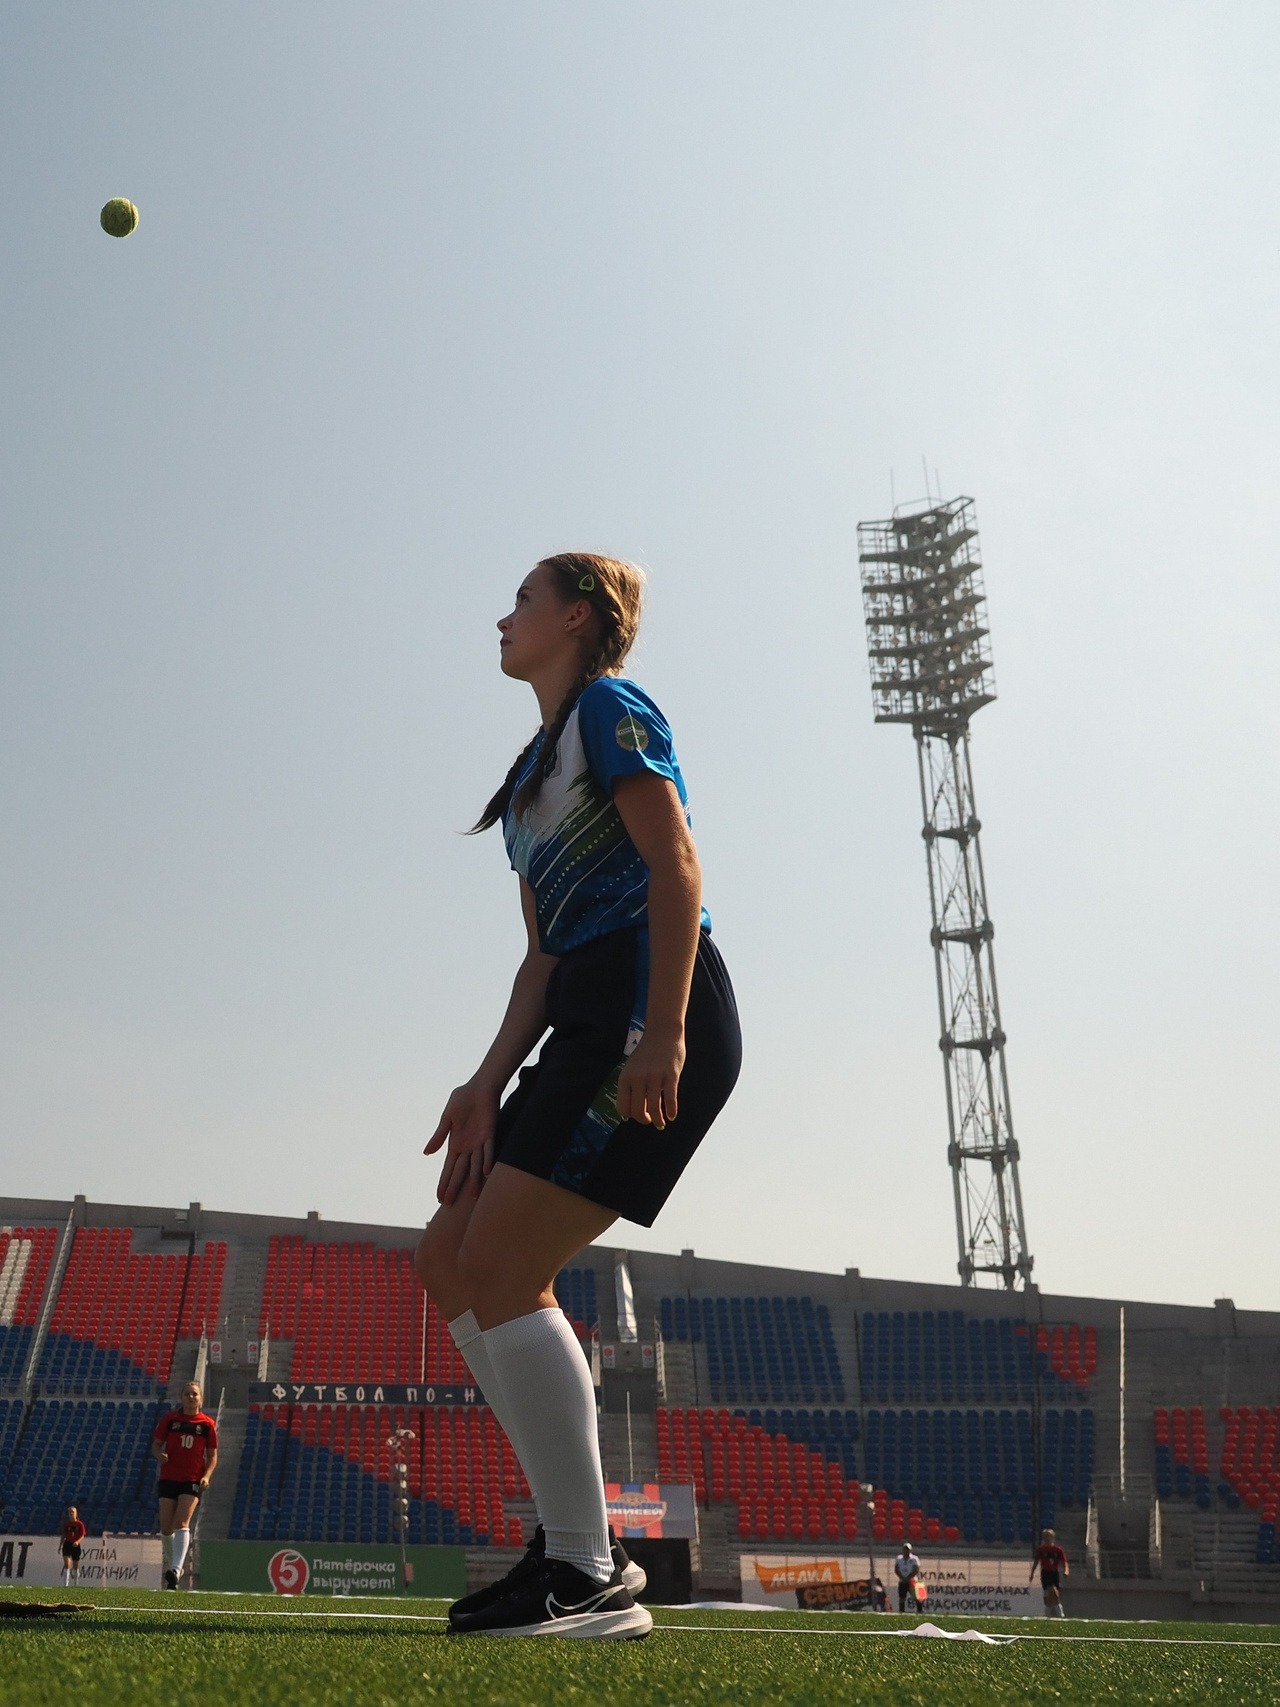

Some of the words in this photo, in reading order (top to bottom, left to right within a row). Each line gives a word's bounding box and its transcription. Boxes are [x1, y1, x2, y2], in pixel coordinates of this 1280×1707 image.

[272, 1384, 385, 1401] ФУТБОЛ
[180, 1434, 194, 1449] 10
[313, 1558, 396, 1575] Пятёрочка
[313, 1577, 396, 1595] выручает!
[803, 1581, 870, 1605] СЕРВИС
